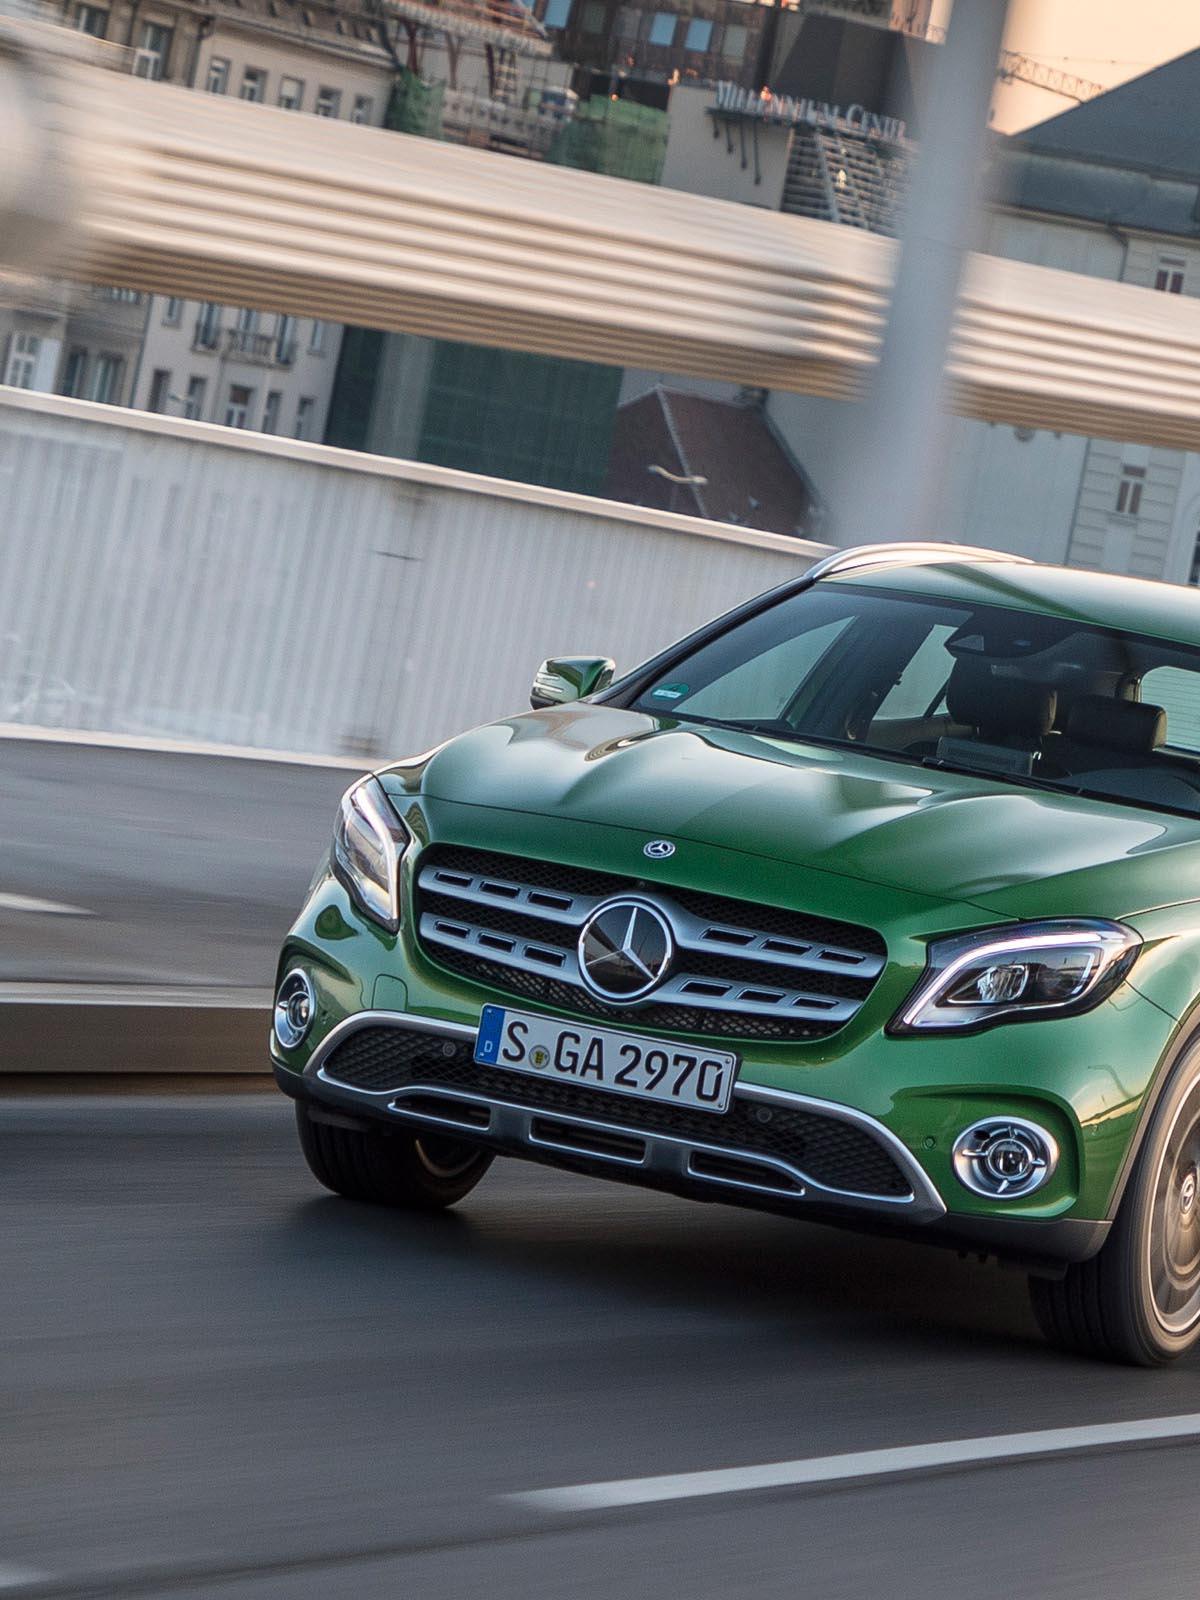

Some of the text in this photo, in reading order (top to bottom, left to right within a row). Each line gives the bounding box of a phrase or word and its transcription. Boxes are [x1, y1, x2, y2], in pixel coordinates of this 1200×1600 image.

[483, 1039, 493, 1053] D
[502, 1021, 723, 1102] S GA 2970
